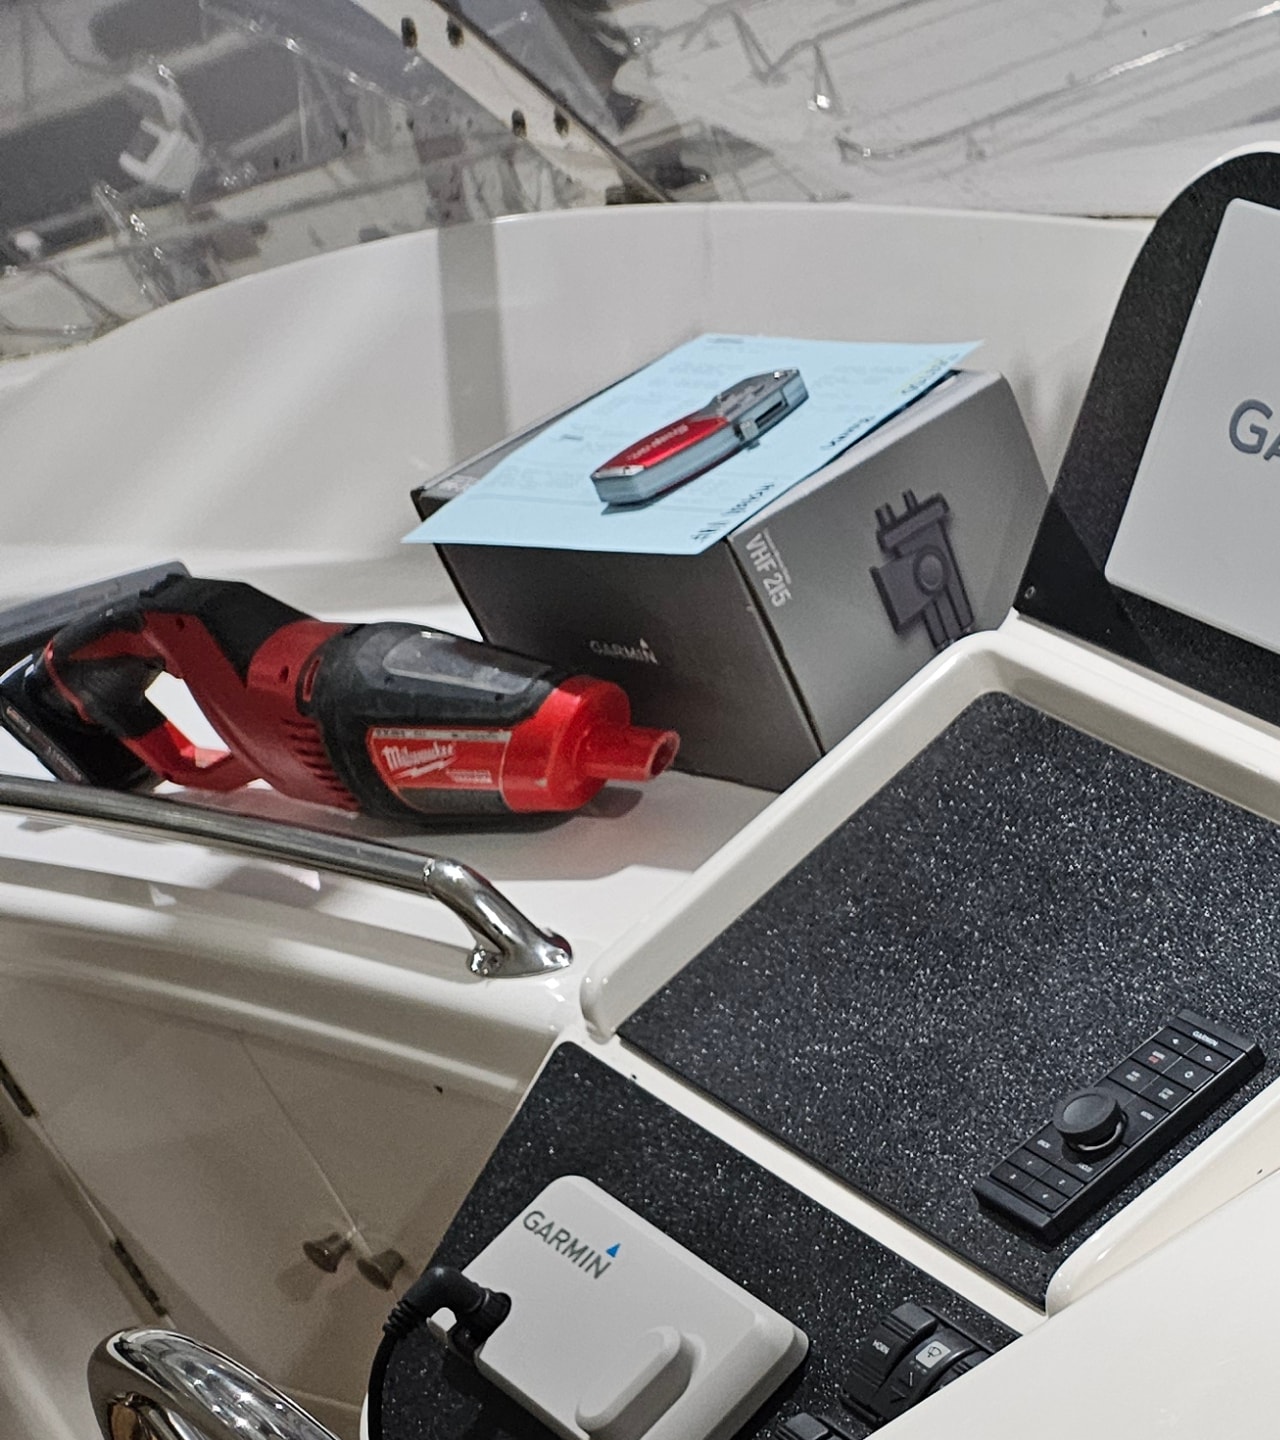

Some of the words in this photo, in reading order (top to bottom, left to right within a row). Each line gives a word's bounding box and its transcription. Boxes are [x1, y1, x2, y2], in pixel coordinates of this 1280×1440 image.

[746, 532, 778, 572] VHF
[763, 572, 793, 607] 215
[589, 640, 658, 664] GARMIN
[522, 1209, 612, 1280] GARMIN
